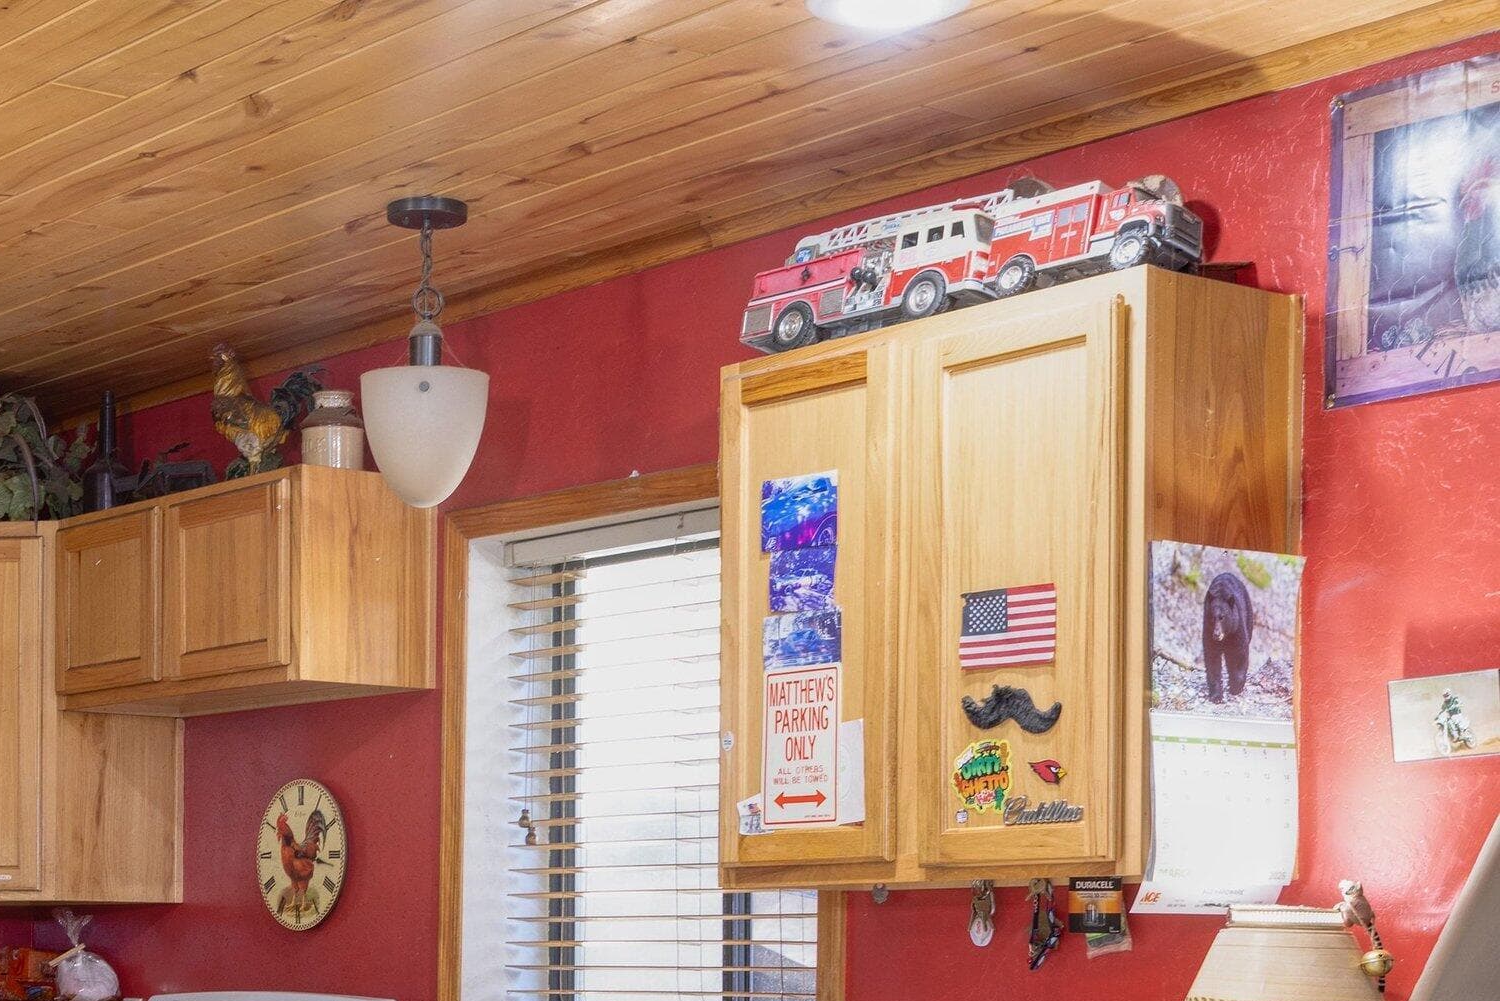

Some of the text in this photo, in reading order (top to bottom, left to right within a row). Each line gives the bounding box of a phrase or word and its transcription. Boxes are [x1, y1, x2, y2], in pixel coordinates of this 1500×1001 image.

[769, 675, 835, 707] MATTHEW'S
[774, 706, 829, 735] PARKING
[785, 735, 818, 762] ONLY
[777, 767, 792, 776] ALL
[960, 753, 1002, 780] DIRTY
[792, 776, 803, 785] BE
[1075, 880, 1115, 889] DURACELL
